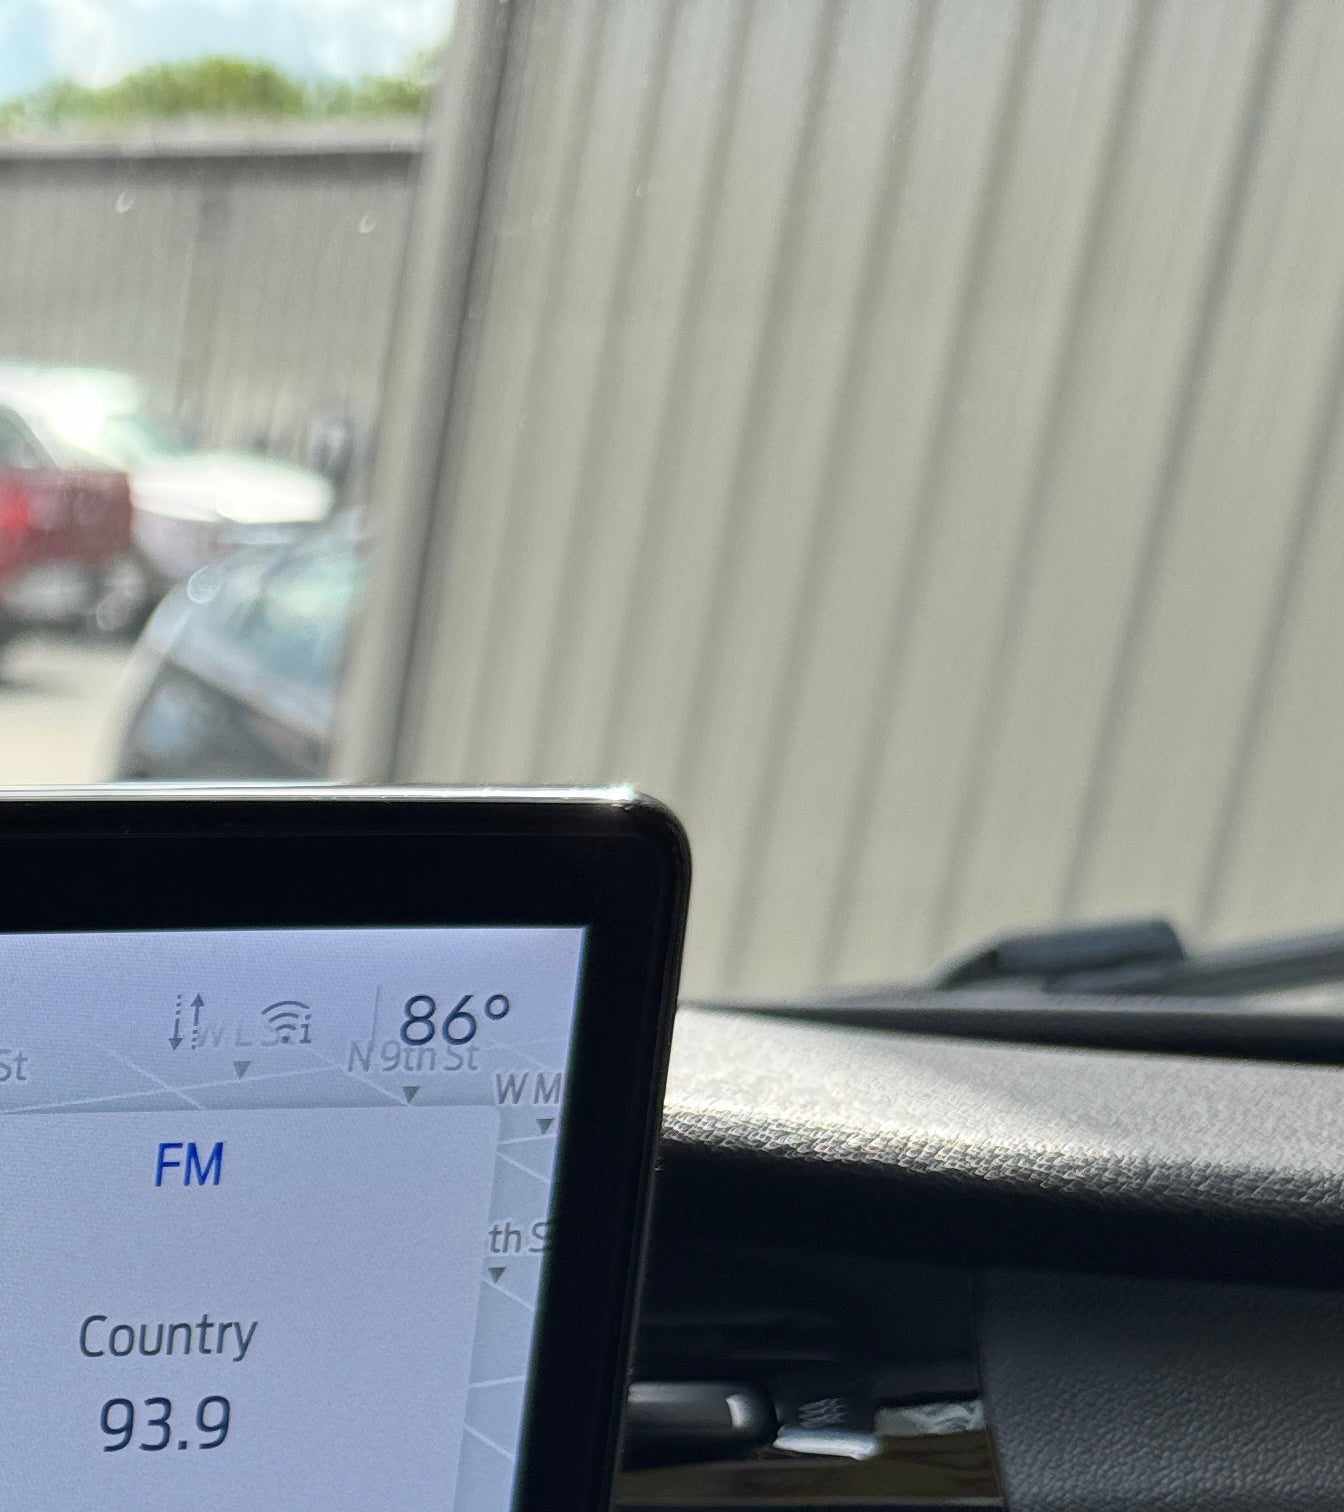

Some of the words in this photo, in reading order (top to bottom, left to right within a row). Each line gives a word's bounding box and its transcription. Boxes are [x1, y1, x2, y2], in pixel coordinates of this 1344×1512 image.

[400, 993, 510, 1047] 86°
[346, 1041, 375, 1073] N
[443, 1041, 479, 1071] St
[495, 1073, 528, 1105] W
[154, 1141, 225, 1188] FM
[78, 1314, 259, 1363] Country
[98, 1395, 232, 1453] 93.9
